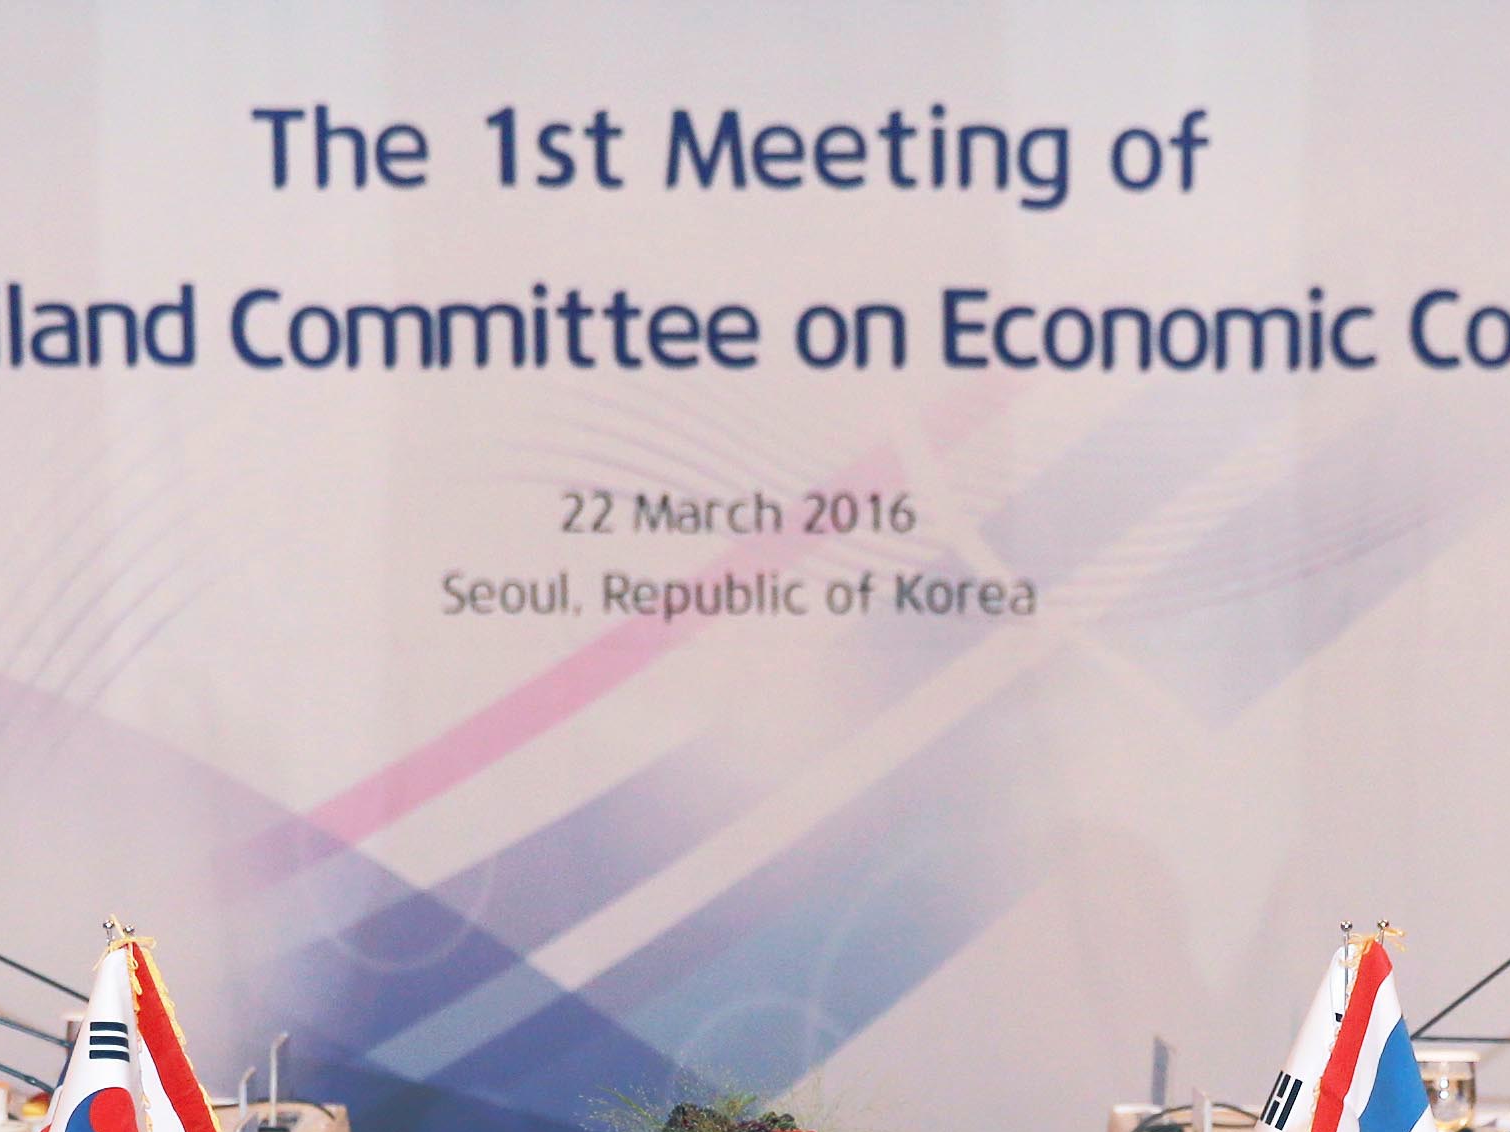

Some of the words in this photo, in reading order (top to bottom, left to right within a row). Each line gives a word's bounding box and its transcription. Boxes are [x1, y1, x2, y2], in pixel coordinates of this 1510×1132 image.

[251, 104, 431, 190] The
[485, 106, 625, 190] 1st
[665, 103, 1071, 212] Meeting
[1109, 109, 1211, 193] of
[229, 282, 761, 371] Committee
[794, 303, 907, 370] on
[941, 286, 1378, 372] Economic
[561, 490, 615, 534] 22
[634, 492, 784, 534] March
[803, 493, 917, 534] 2016
[603, 572, 805, 623] Republic
[826, 571, 874, 615] of
[894, 573, 1037, 616] Korea
